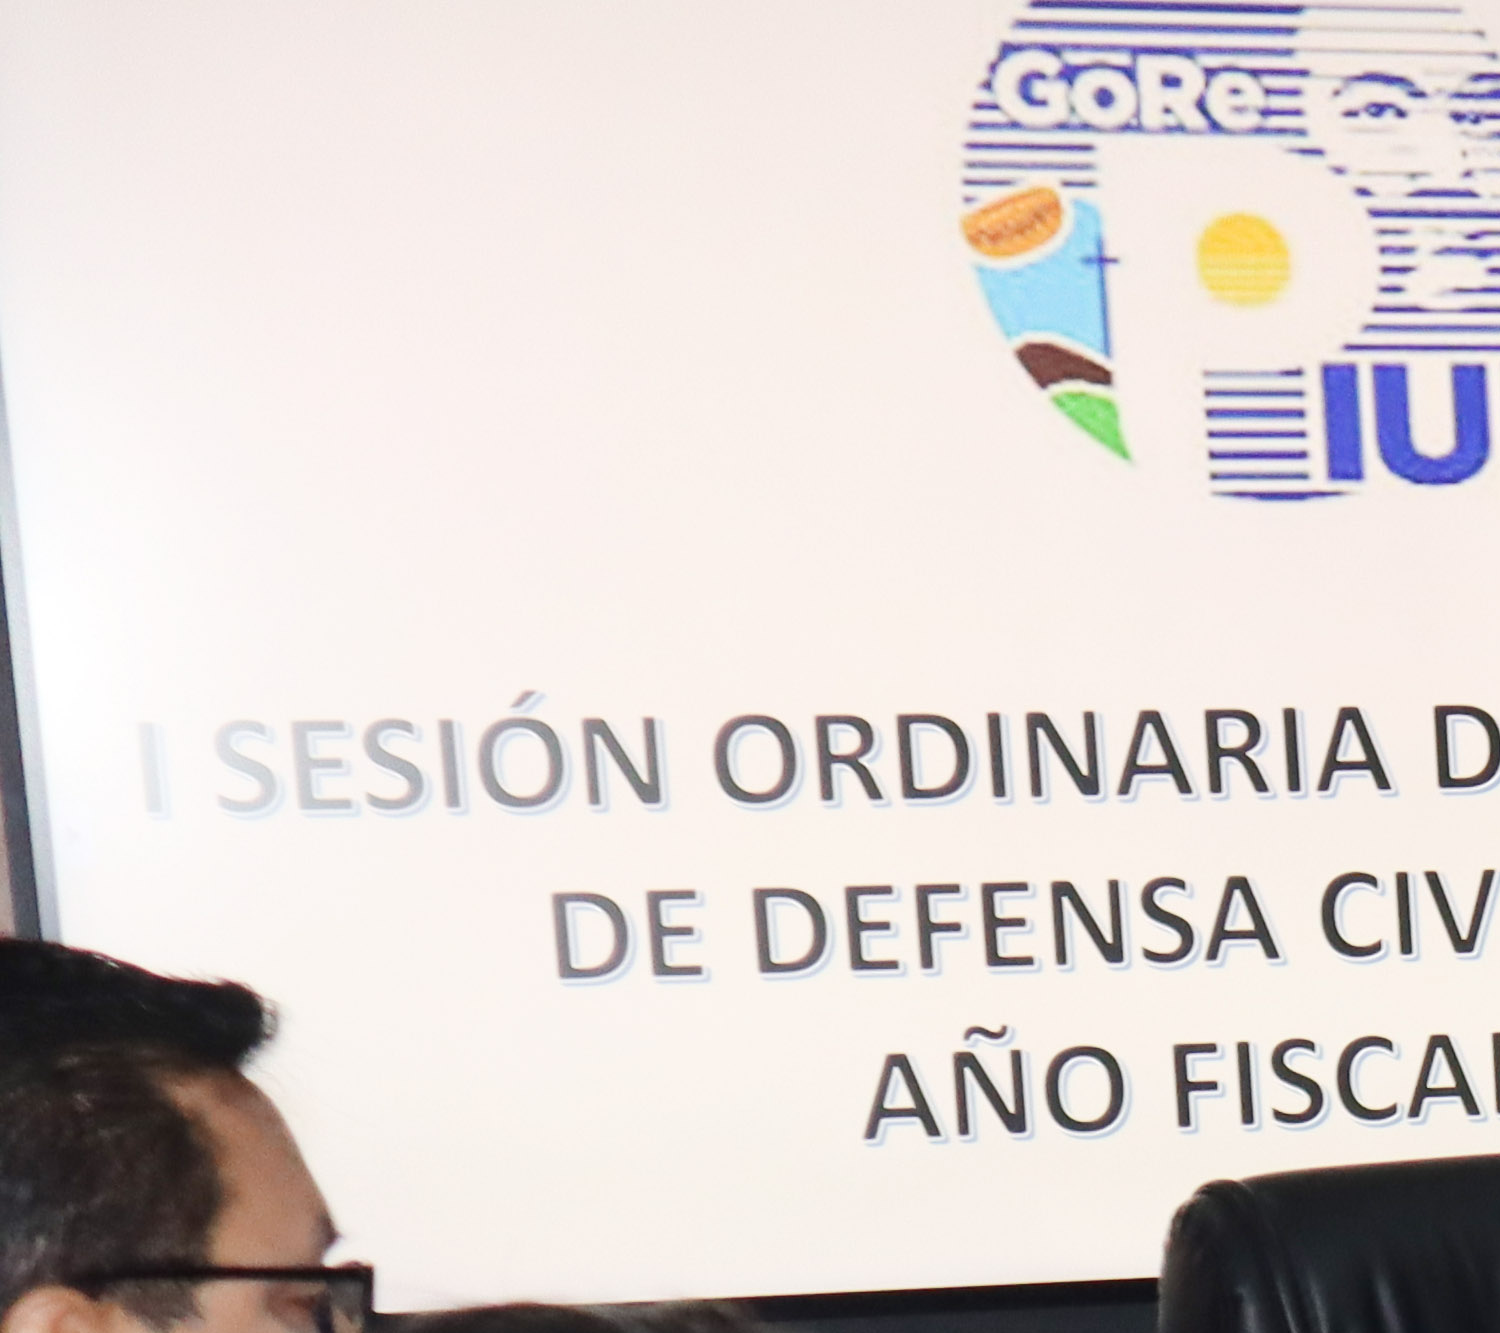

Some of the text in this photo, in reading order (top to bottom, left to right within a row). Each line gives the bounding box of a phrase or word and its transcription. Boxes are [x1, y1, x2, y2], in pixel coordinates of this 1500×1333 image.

[992, 48, 1266, 131] GoRe
[213, 690, 665, 813] SESIÓN
[714, 705, 1393, 805] ORDINARIA
[555, 889, 703, 980] DE
[752, 874, 1281, 975] DEFENSA
[864, 1028, 1126, 1141] AÑO
